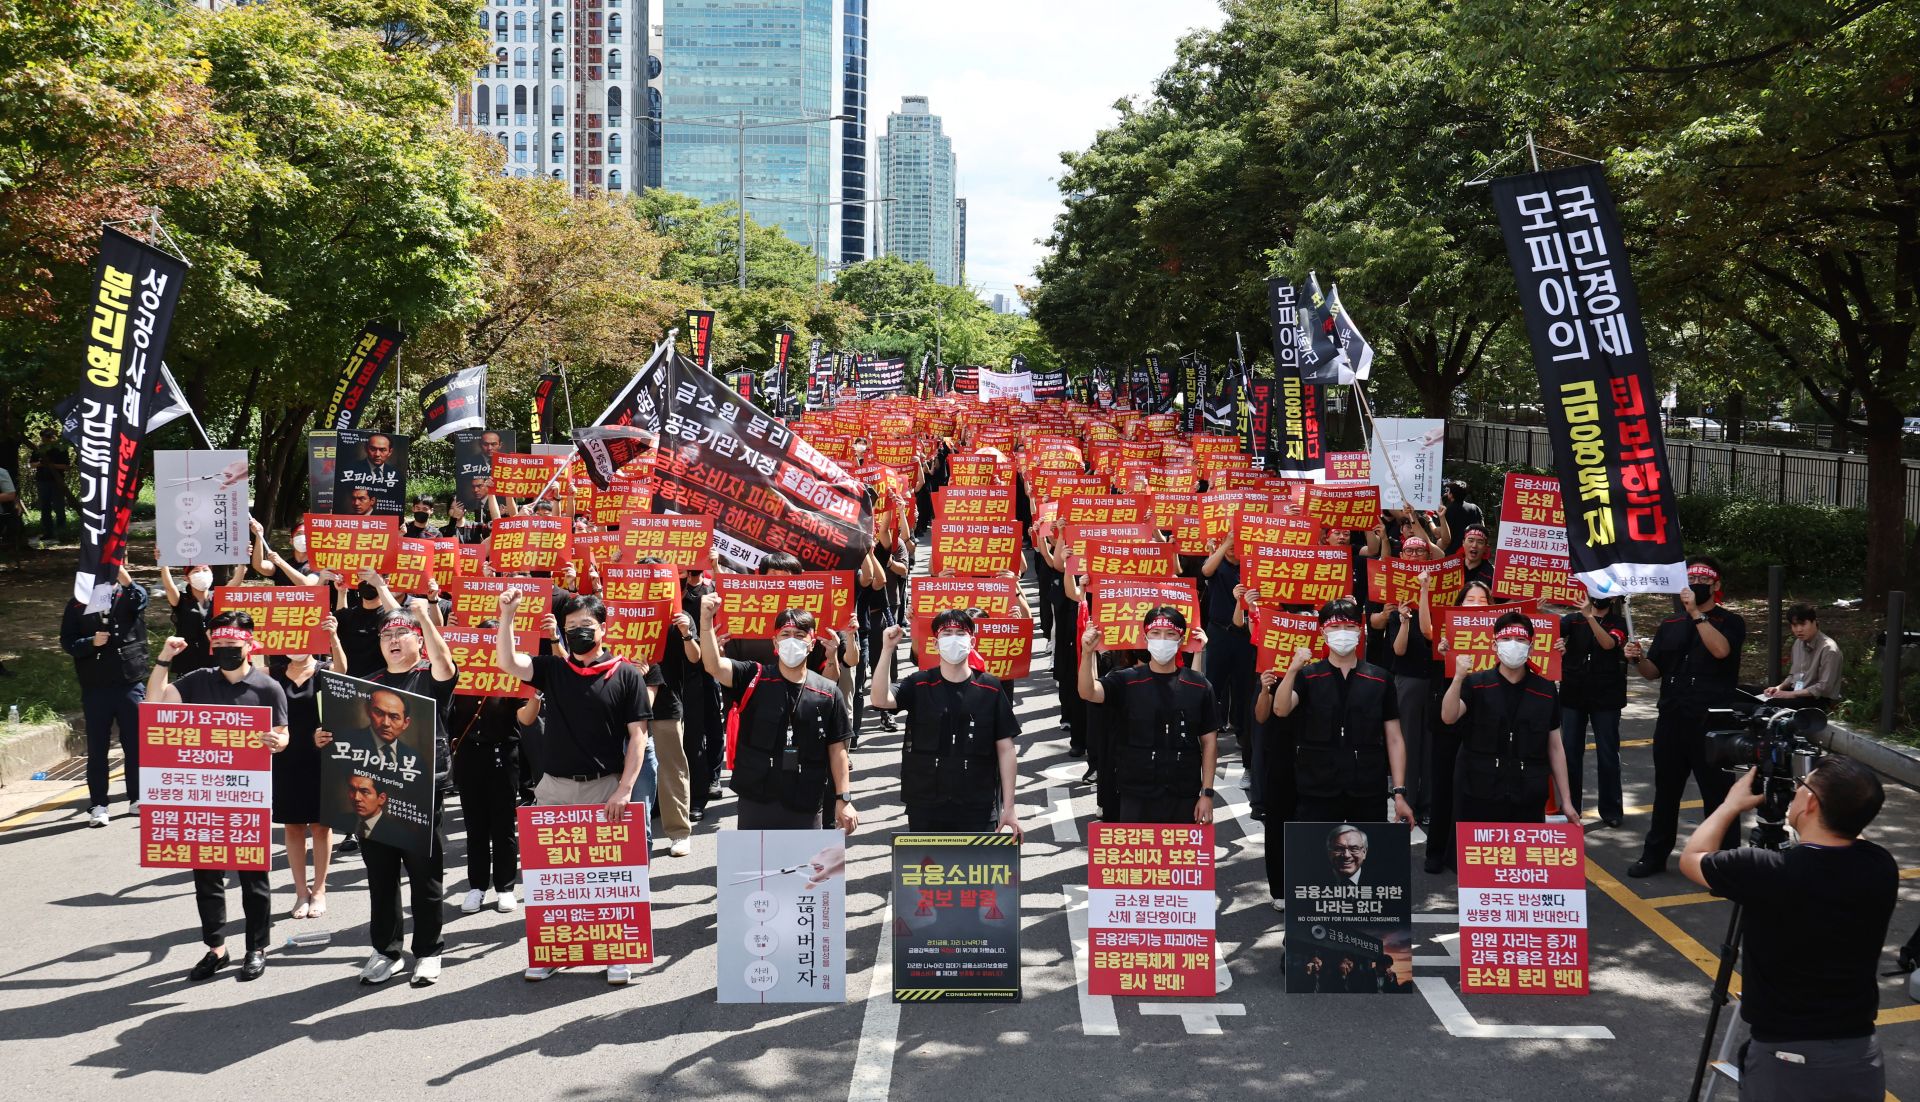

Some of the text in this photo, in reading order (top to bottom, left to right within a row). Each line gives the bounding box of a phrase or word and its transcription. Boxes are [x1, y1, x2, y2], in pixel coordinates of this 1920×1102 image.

[1556, 185, 1633, 357] 국민경제
[123, 268, 168, 427] 성공사례
[1278, 287, 1304, 460] 모피아의 금융독재
[1516, 191, 1615, 548] 모피아의 금융독재
[1186, 367, 1196, 403] 분리형
[81, 265, 133, 546] 분리형 감독기구
[675, 380, 741, 425] 금소원
[746, 414, 789, 449] 분리
[1252, 386, 1269, 449] 무너지는
[493, 464, 549, 480] 금융소비자
[665, 412, 855, 519] 공공기관 지정 철회하라!
[953, 464, 993, 474] 금소원 분리
[341, 470, 399, 487] 모피아의 봄
[1413, 452, 1426, 502] 끊어버리자
[595, 496, 650, 509] 금소원 분리
[655, 447, 745, 500] 금융소비자
[750, 484, 784, 516] 피해
[785, 507, 849, 547] 초래하는
[1517, 491, 1554, 508] 금소원
[944, 500, 1009, 513] 금소원 분리
[1070, 508, 1137, 522] 금소원 분리
[1155, 503, 1187, 514] 금소원
[1309, 500, 1376, 513] 금소원 분리
[1521, 507, 1546, 523] 결사
[213, 494, 230, 555] 끊어버리자
[1342, 516, 1373, 528] 반대!
[311, 532, 389, 550] 금소원 분리
[494, 533, 567, 548] 금감원 독립성
[625, 530, 664, 546] 금감원
[668, 531, 707, 547] 독립성
[725, 505, 762, 536] 해체
[766, 525, 842, 570] 중단하라!
[1240, 527, 1311, 545] 금소원 분리
[1505, 538, 1548, 550] 금융소비자
[939, 537, 1015, 553] 금소원 분리
[315, 553, 384, 570] 반대한다!
[397, 555, 426, 570] 분리
[501, 553, 557, 567] 보장하라!
[1092, 556, 1168, 575] 금융소비자
[1257, 561, 1347, 582] 금소원 분리
[225, 592, 315, 602] 국제기준에 부합하는
[1259, 581, 1344, 601] 결사 반대!
[723, 593, 822, 611] 금소원 분리
[917, 595, 1008, 613] 금소원 분리
[272, 607, 322, 625] 독립성
[619, 607, 654, 617] 막아내고
[1100, 602, 1153, 622] 금소원
[728, 617, 766, 634] 결사
[982, 624, 1019, 634] 부합하는
[1272, 616, 1317, 631] 국제기준에
[443, 633, 480, 642] 관치금융
[1104, 626, 1139, 645] 결사
[978, 637, 1026, 656] 독립성
[157, 710, 253, 726] IMF가 요구하는
[147, 726, 264, 748] 금감원 독립성
[178, 749, 233, 764] 보장하라
[332, 742, 421, 782] 모피아의 봄
[161, 772, 249, 786] 영국도 반성했다
[354, 769, 403, 788] MOFIA's spring
[531, 809, 593, 824] 금융소비자
[152, 828, 260, 843] 감독 효율은 감소!
[537, 826, 628, 845] 금소원 분리
[1100, 829, 1203, 845] 금융감독 업무와
[1474, 829, 1567, 844] IMF가 요구하는
[147, 844, 264, 864] 금소원 분리 반대
[547, 845, 622, 864] 결사 반대
[1094, 849, 1210, 865] 금융소비자 보호는
[1465, 846, 1577, 866] 금감원 독립성
[540, 871, 632, 885] 관치금융으로부터
[902, 865, 1011, 885] 금융소비자
[1102, 868, 1201, 885] 일체불가분이다!
[1495, 869, 1548, 883] 보장하라
[533, 886, 640, 900] 금융소비자 지켜내자
[917, 890, 997, 908] 경보 발령
[1115, 894, 1189, 907] 금소원 분리는
[1295, 886, 1402, 899] 금융소비자를 위한
[1480, 893, 1565, 906] 영국도 반성했다
[1316, 901, 1382, 913] 나라는 없다
[1467, 909, 1579, 923] 쌍봉형 체계 반대한다
[540, 924, 639, 943] 금융소비자는
[796, 896, 817, 988] 끊어버리자
[1096, 933, 1207, 947] 금융감독기능 파괴하는
[1329, 929, 1379, 952] 금융소비자보호원
[534, 943, 647, 962] 피눈물 흘린다!
[1094, 952, 1209, 969] 금융감독체계 개악
[1120, 974, 1184, 990] 결사 반대!
[1468, 968, 1582, 988] 금소원 분리 반대
